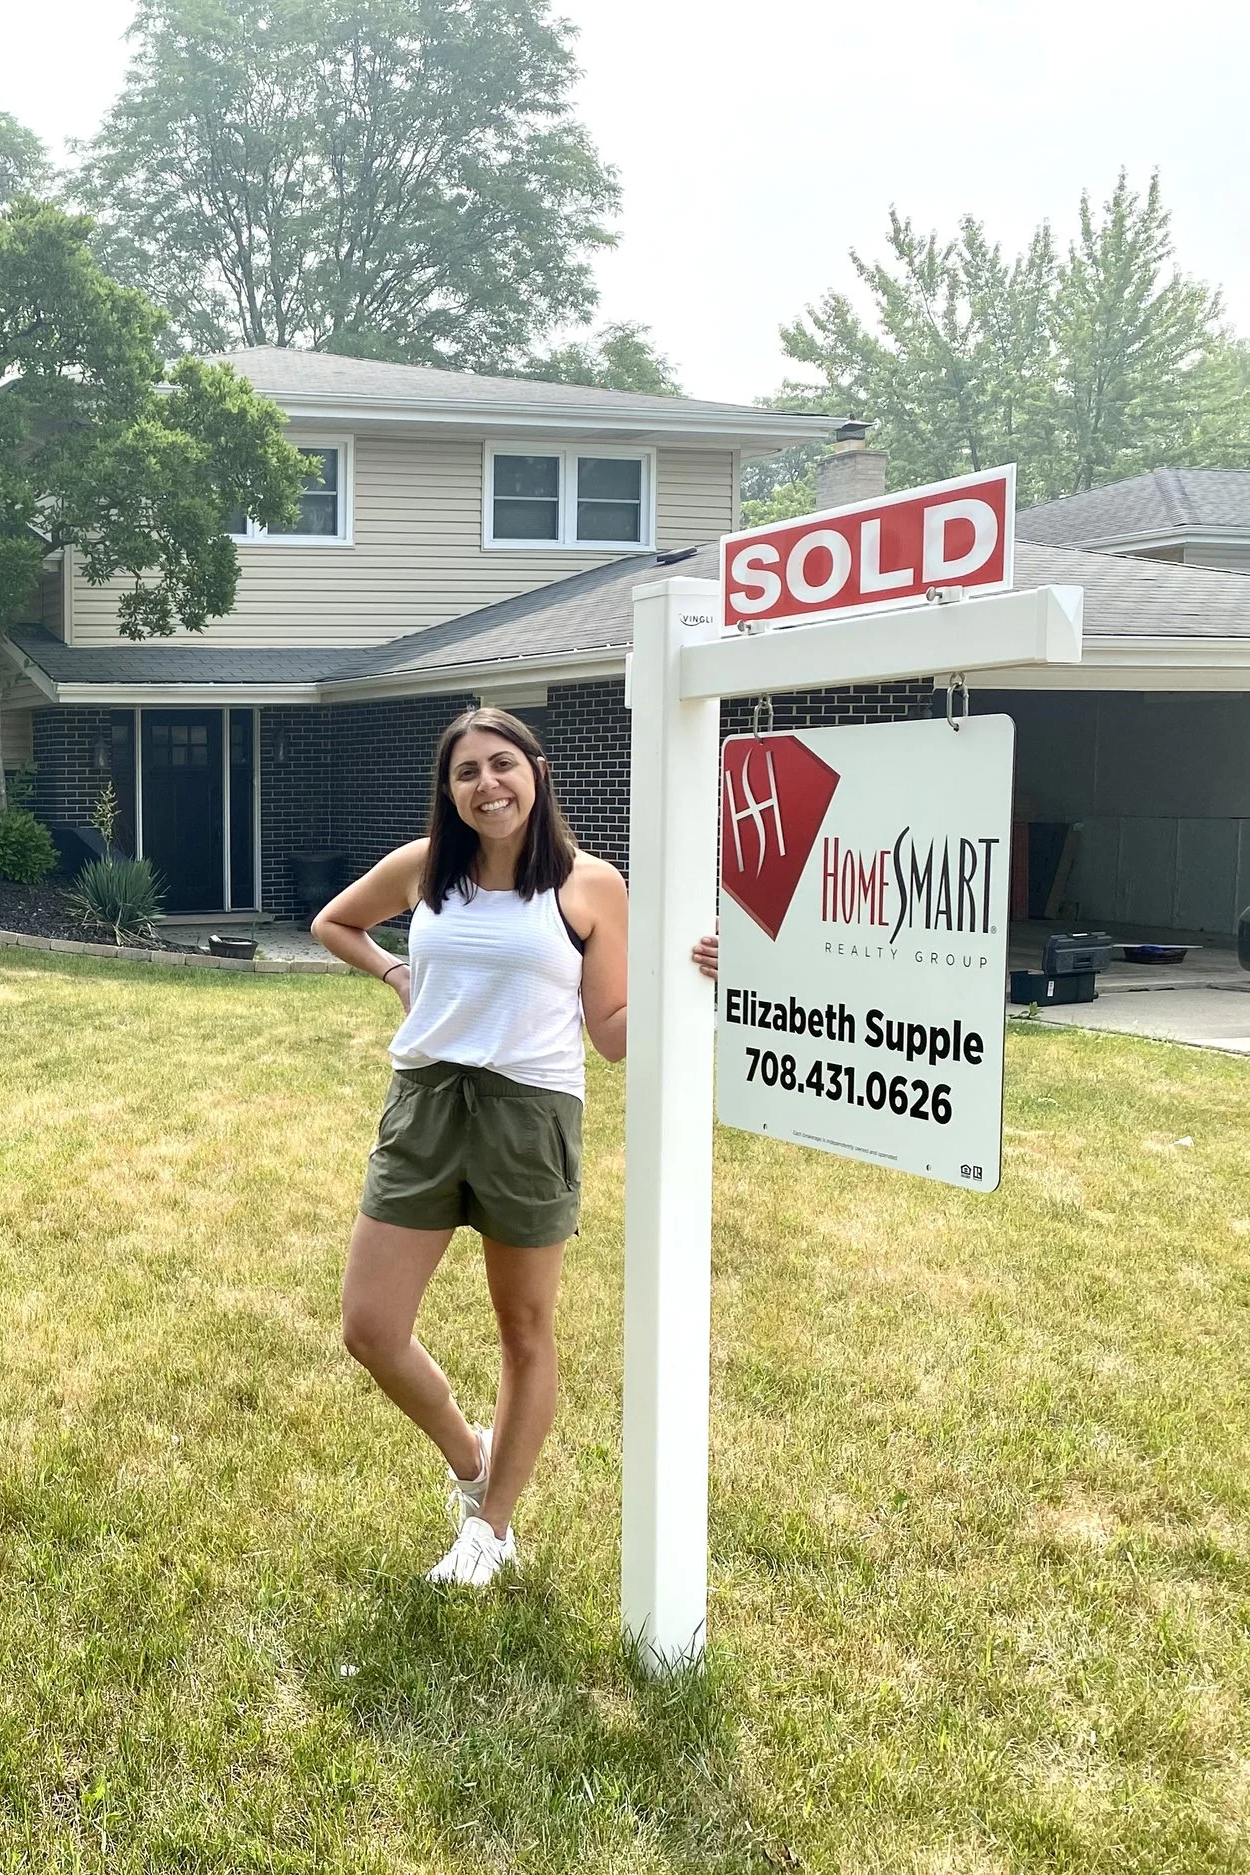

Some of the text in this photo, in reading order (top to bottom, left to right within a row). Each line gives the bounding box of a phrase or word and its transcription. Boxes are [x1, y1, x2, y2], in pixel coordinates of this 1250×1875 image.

[729, 498, 998, 614] SOLD
[681, 615, 714, 625] VINGLI
[825, 942, 988, 968] REALTY GROUP
[726, 988, 984, 1065] Elizabeth Supple
[745, 1047, 952, 1125] 708.431.0626
